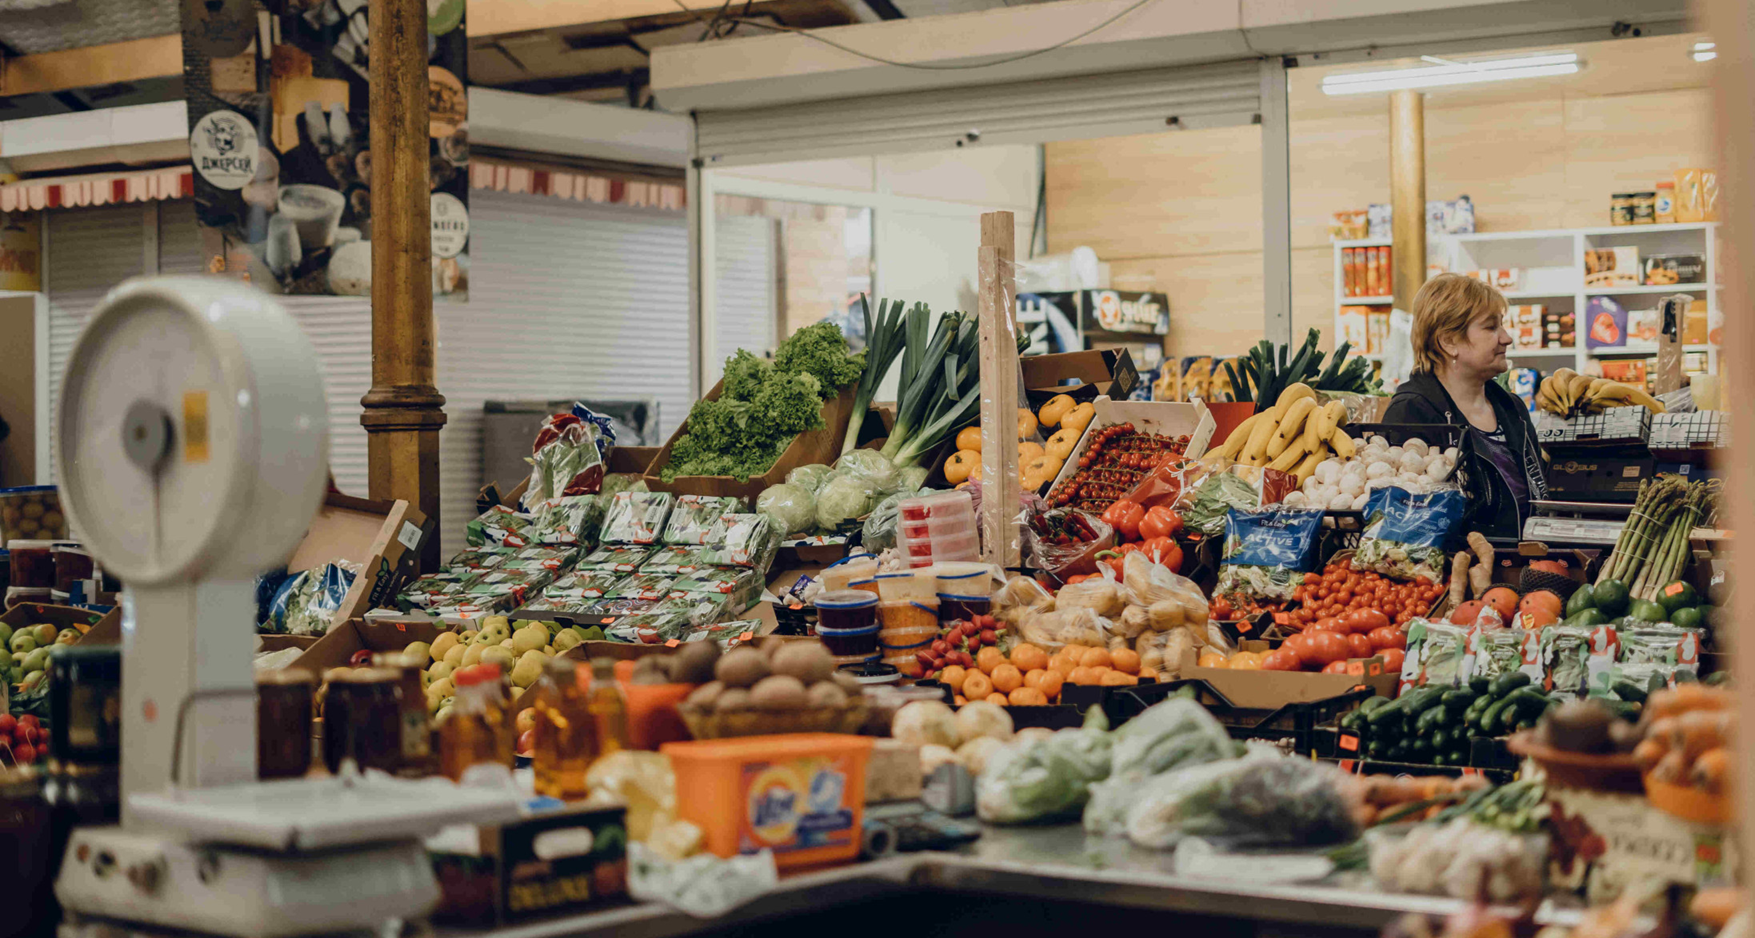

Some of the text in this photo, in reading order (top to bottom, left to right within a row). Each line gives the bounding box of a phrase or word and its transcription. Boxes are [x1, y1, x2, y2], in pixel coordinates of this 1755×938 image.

[202, 156, 253, 173] ДЖЕРСЕЙ
[1553, 461, 1598, 474] GLOBUS
[1245, 533, 1294, 546] ACTIVE
